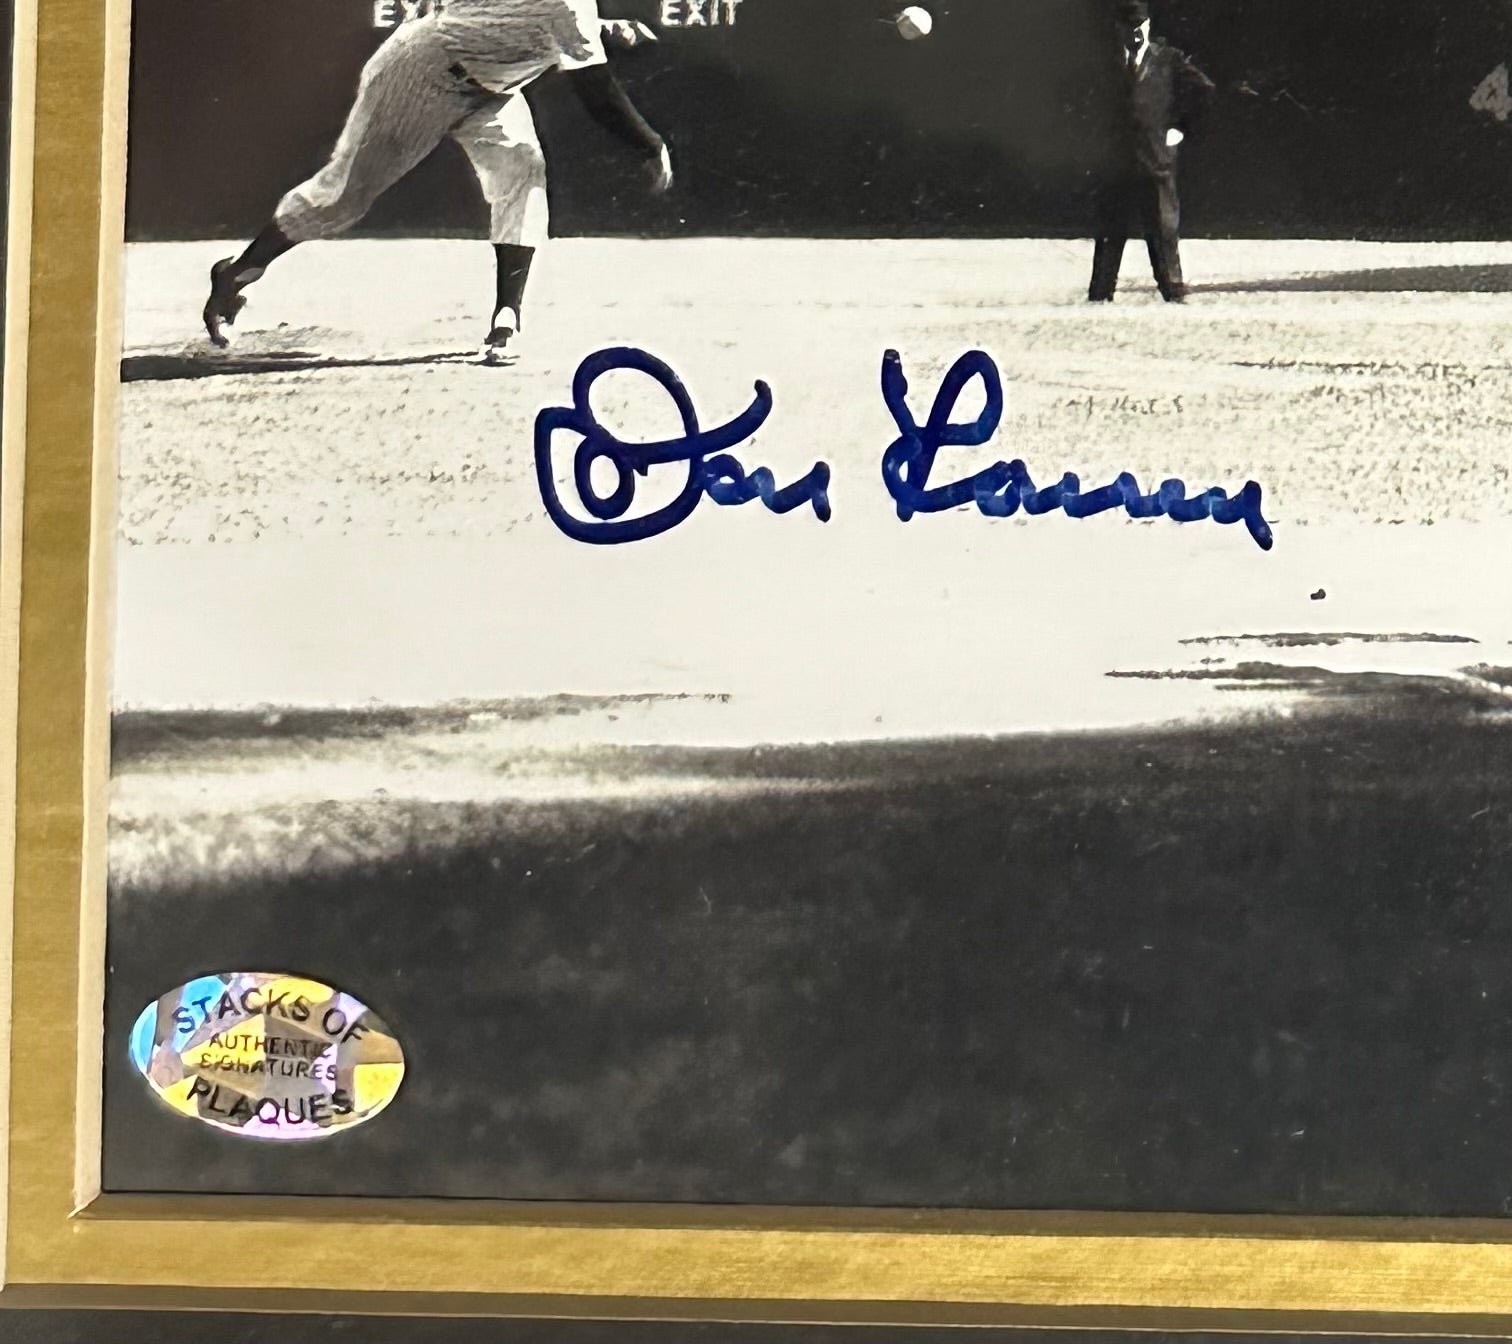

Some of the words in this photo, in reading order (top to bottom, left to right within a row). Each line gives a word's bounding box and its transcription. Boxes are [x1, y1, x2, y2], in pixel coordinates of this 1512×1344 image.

[173, 987, 313, 1033] STACKS
[322, 1008, 371, 1045] OF
[209, 1033, 335, 1059] AUTHENTIC
[199, 1058, 337, 1081] SIGNATURES
[187, 1076, 353, 1126] PLAQUES
